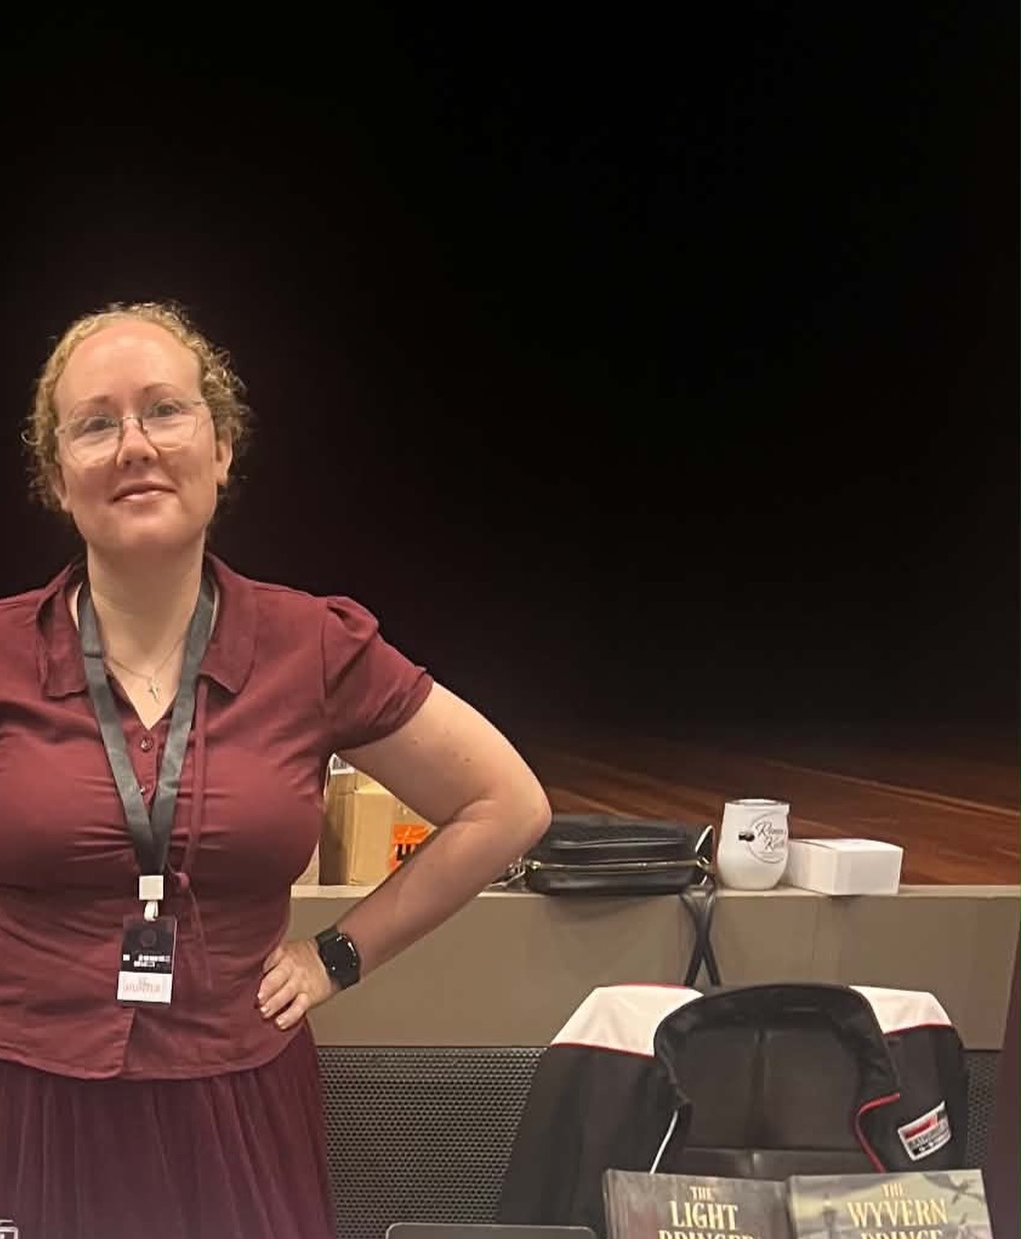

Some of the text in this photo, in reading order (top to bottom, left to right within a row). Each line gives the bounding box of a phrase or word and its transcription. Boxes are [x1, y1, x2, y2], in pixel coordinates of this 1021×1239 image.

[689, 1186, 713, 1201] THE
[882, 1183, 905, 1198] THE
[671, 1201, 739, 1231] LIGHT
[847, 1199, 949, 1227] WYVERN
